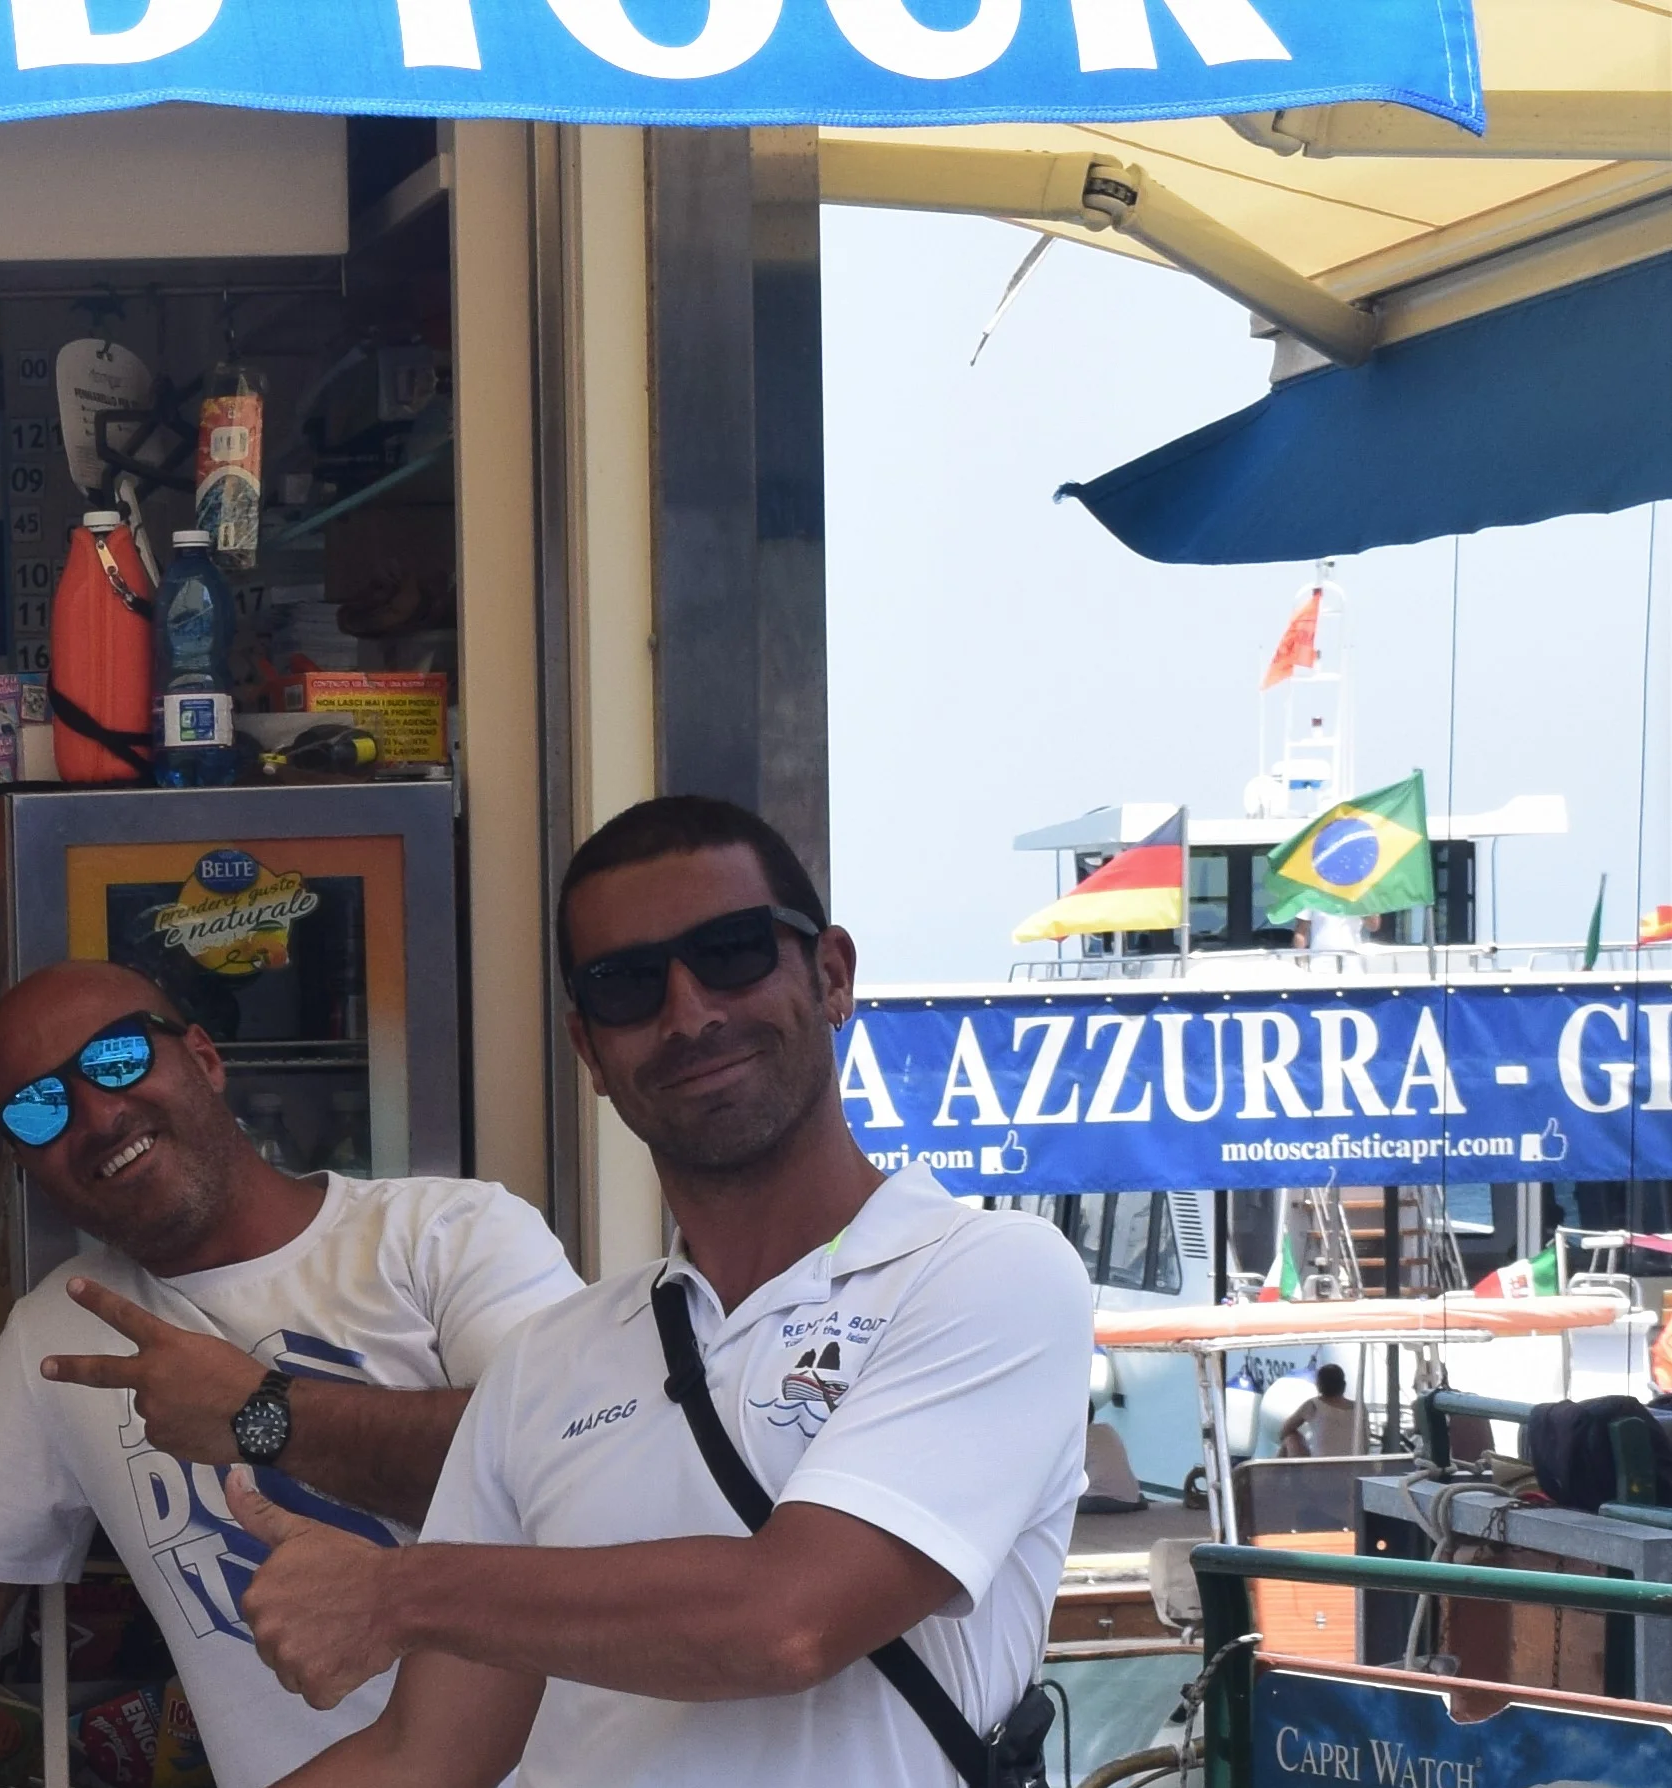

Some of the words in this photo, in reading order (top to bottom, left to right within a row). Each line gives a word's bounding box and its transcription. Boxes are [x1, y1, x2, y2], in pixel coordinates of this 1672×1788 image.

[20, 359, 48, 380] 00
[11, 423, 46, 450] 12
[11, 468, 44, 493] 09
[13, 511, 39, 534] 45
[17, 561, 48, 588] 10
[18, 601, 47, 627] 11
[18, 644, 50, 670] 16
[248, 877, 297, 902] gusto
[166, 922, 183, 946] è
[188, 887, 315, 941] naturale
[933, 1004, 1467, 1128] AZZURRA
[1221, 1131, 1515, 1165] motoscafisticapri.com
[1274, 1725, 1361, 1784] CAPRI
